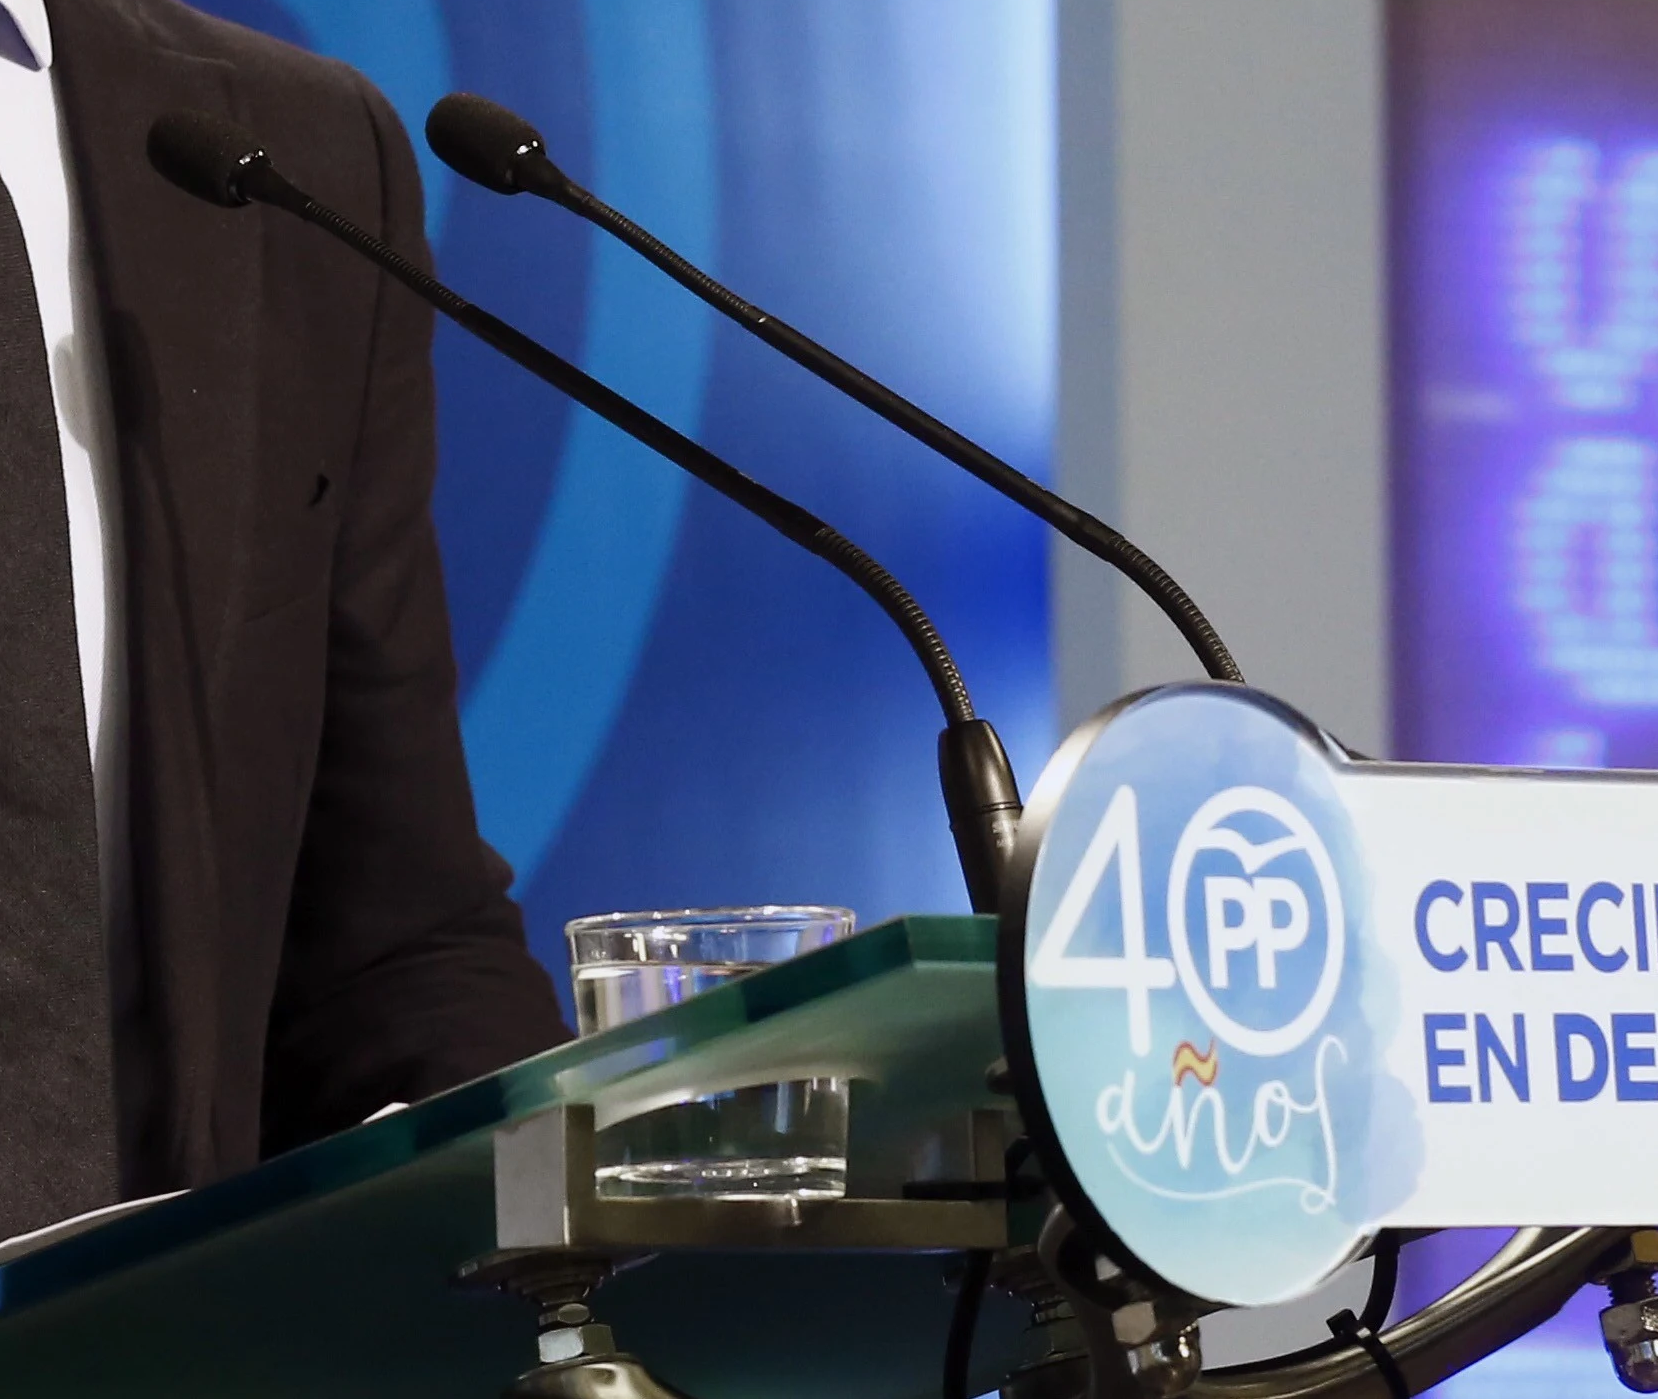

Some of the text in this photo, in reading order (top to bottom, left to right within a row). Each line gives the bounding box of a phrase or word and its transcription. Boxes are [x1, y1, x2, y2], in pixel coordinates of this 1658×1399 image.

[1203, 875, 1310, 990] PP
[1423, 1013, 1531, 1103] EN
[1095, 1035, 1348, 1213] años
